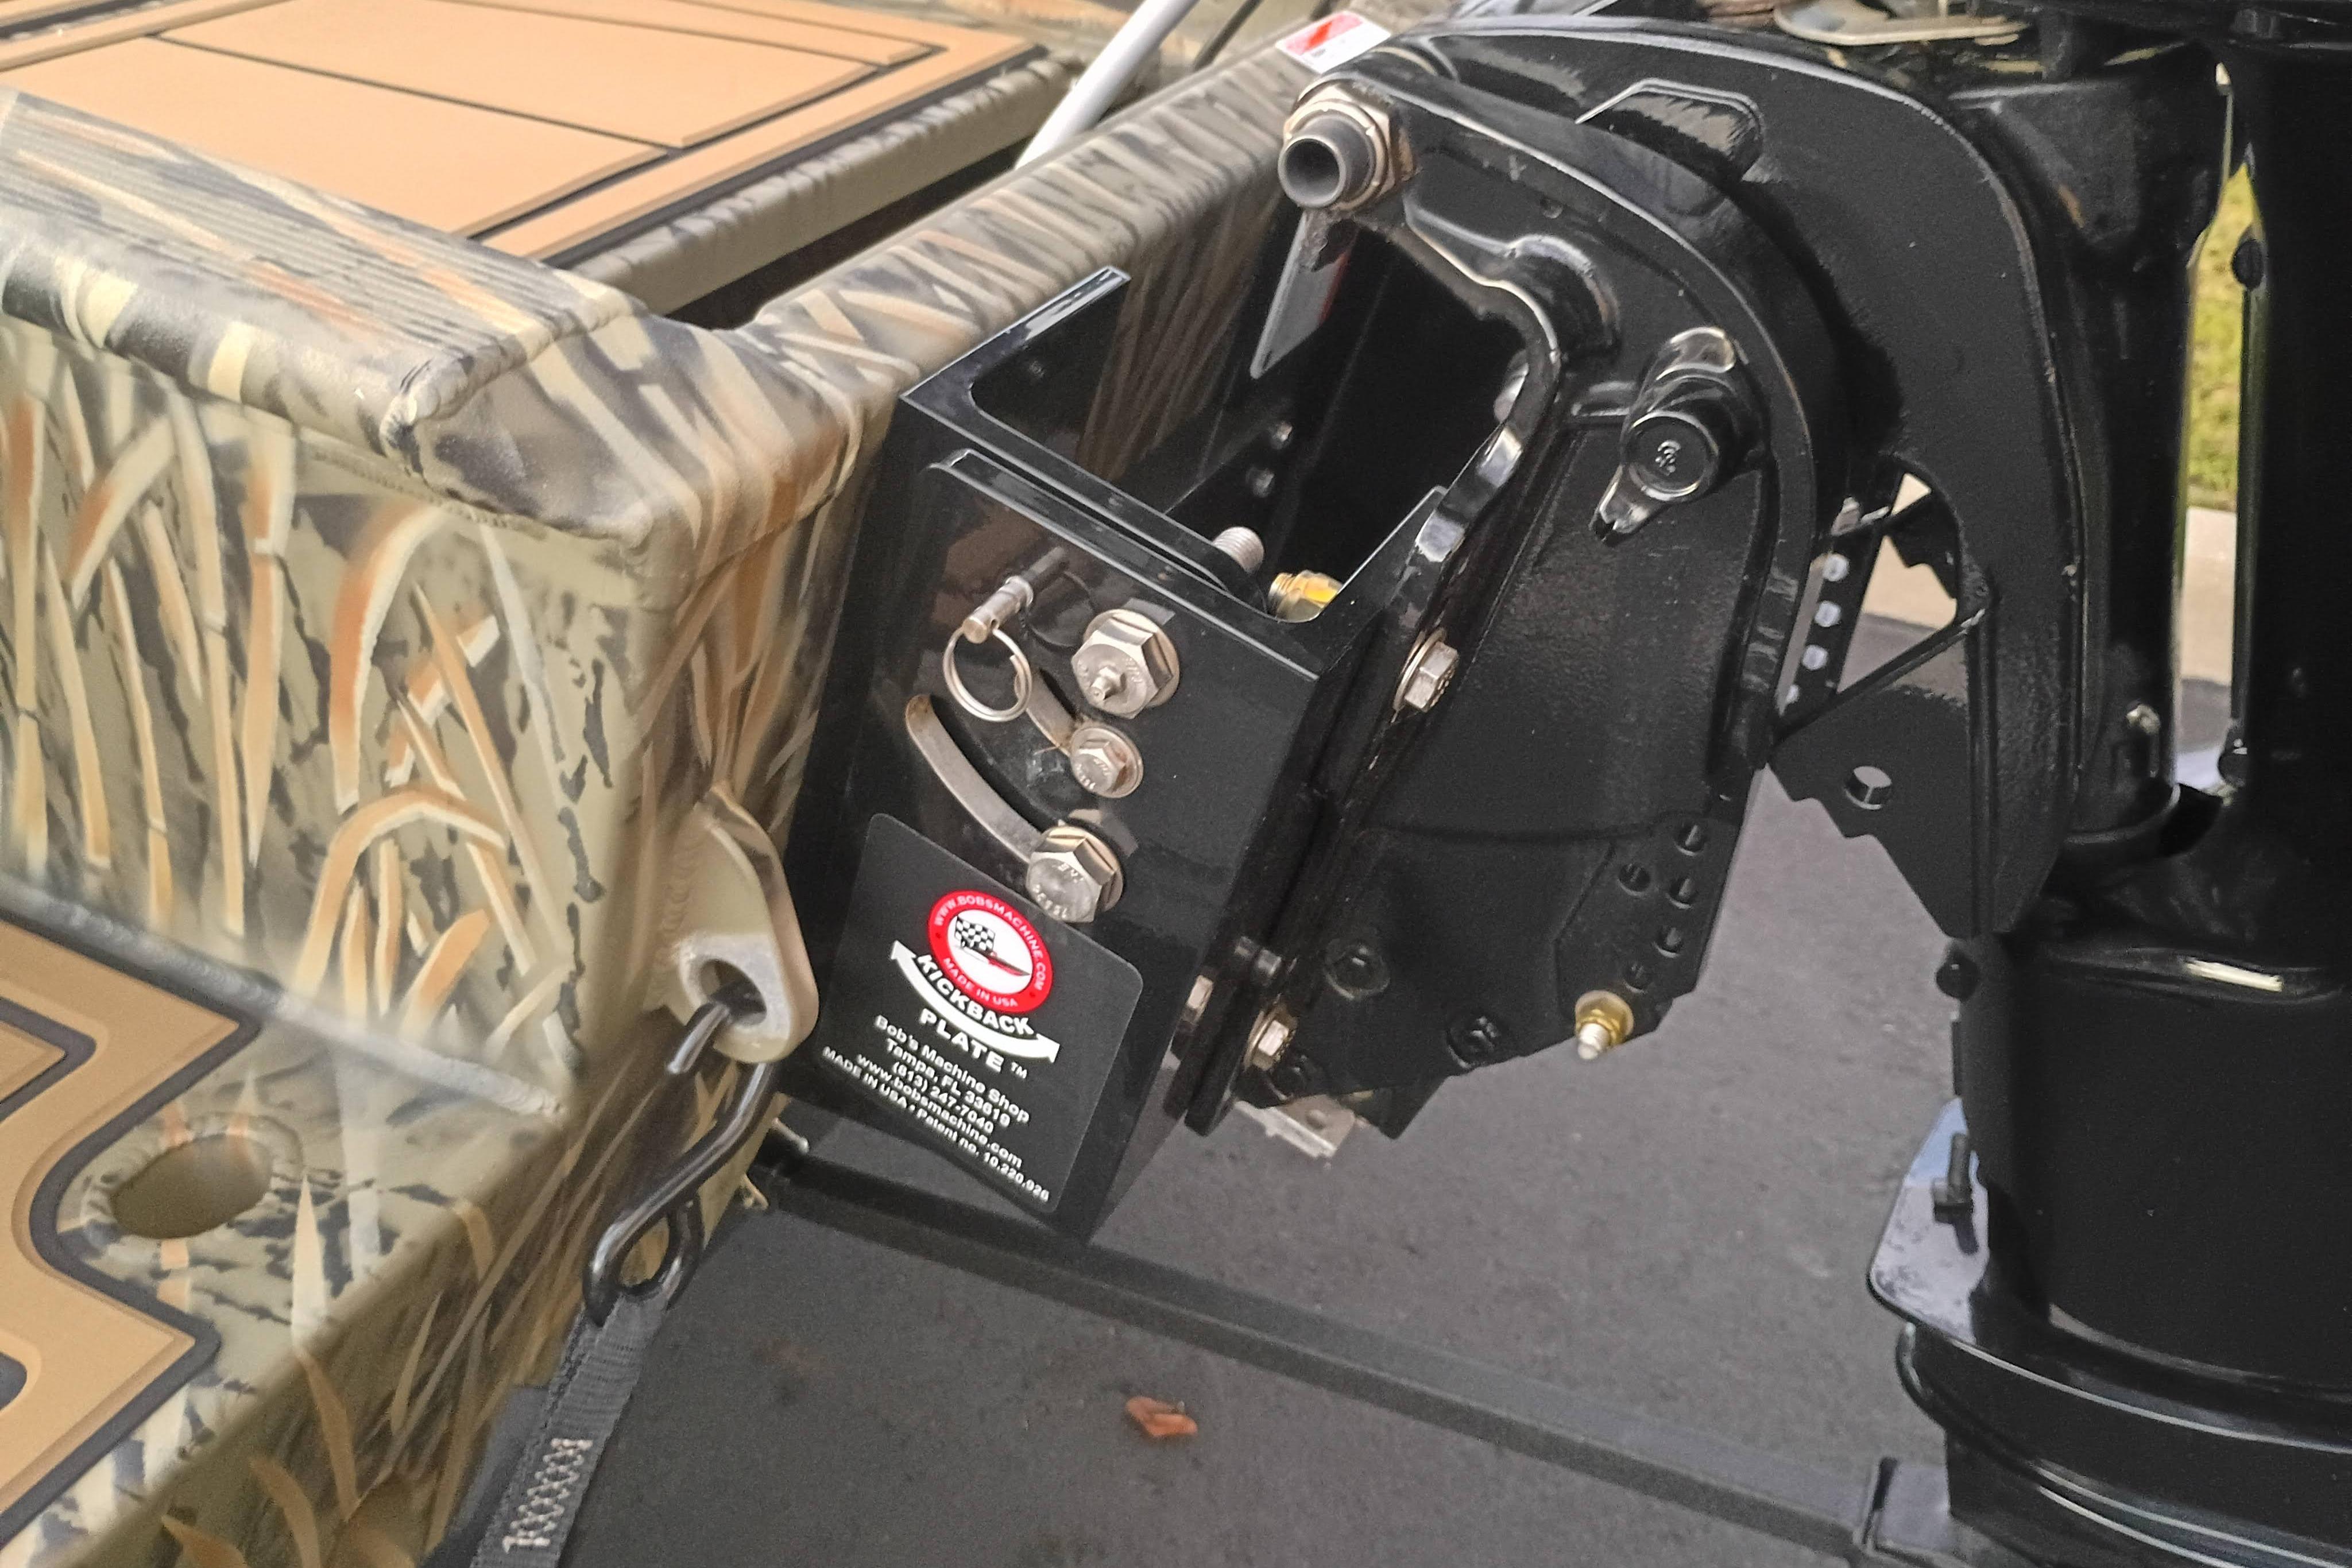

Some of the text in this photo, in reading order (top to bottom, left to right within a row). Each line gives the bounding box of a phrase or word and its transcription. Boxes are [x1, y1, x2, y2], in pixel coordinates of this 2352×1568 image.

[934, 895, 1046, 991] WWW.BOBSMACHINE.COM
[943, 958, 1018, 1008] MADE IN USA
[918, 955, 1034, 1035] KICKBACK
[875, 1015, 1030, 1123] Bob's Machine Shop
[886, 1038, 1011, 1128] Tampa, FL 33619
[919, 1008, 1004, 1073] PLATE
[822, 1046, 862, 1077] MADE
[863, 1073, 878, 1089] IN
[879, 1083, 907, 1109] USA
[917, 1108, 957, 1141] Patent
[959, 1137, 979, 1157] no.
[856, 1054, 1022, 1169] www.bobsmachine.com
[892, 1062, 994, 1135] (813) 247-7040
